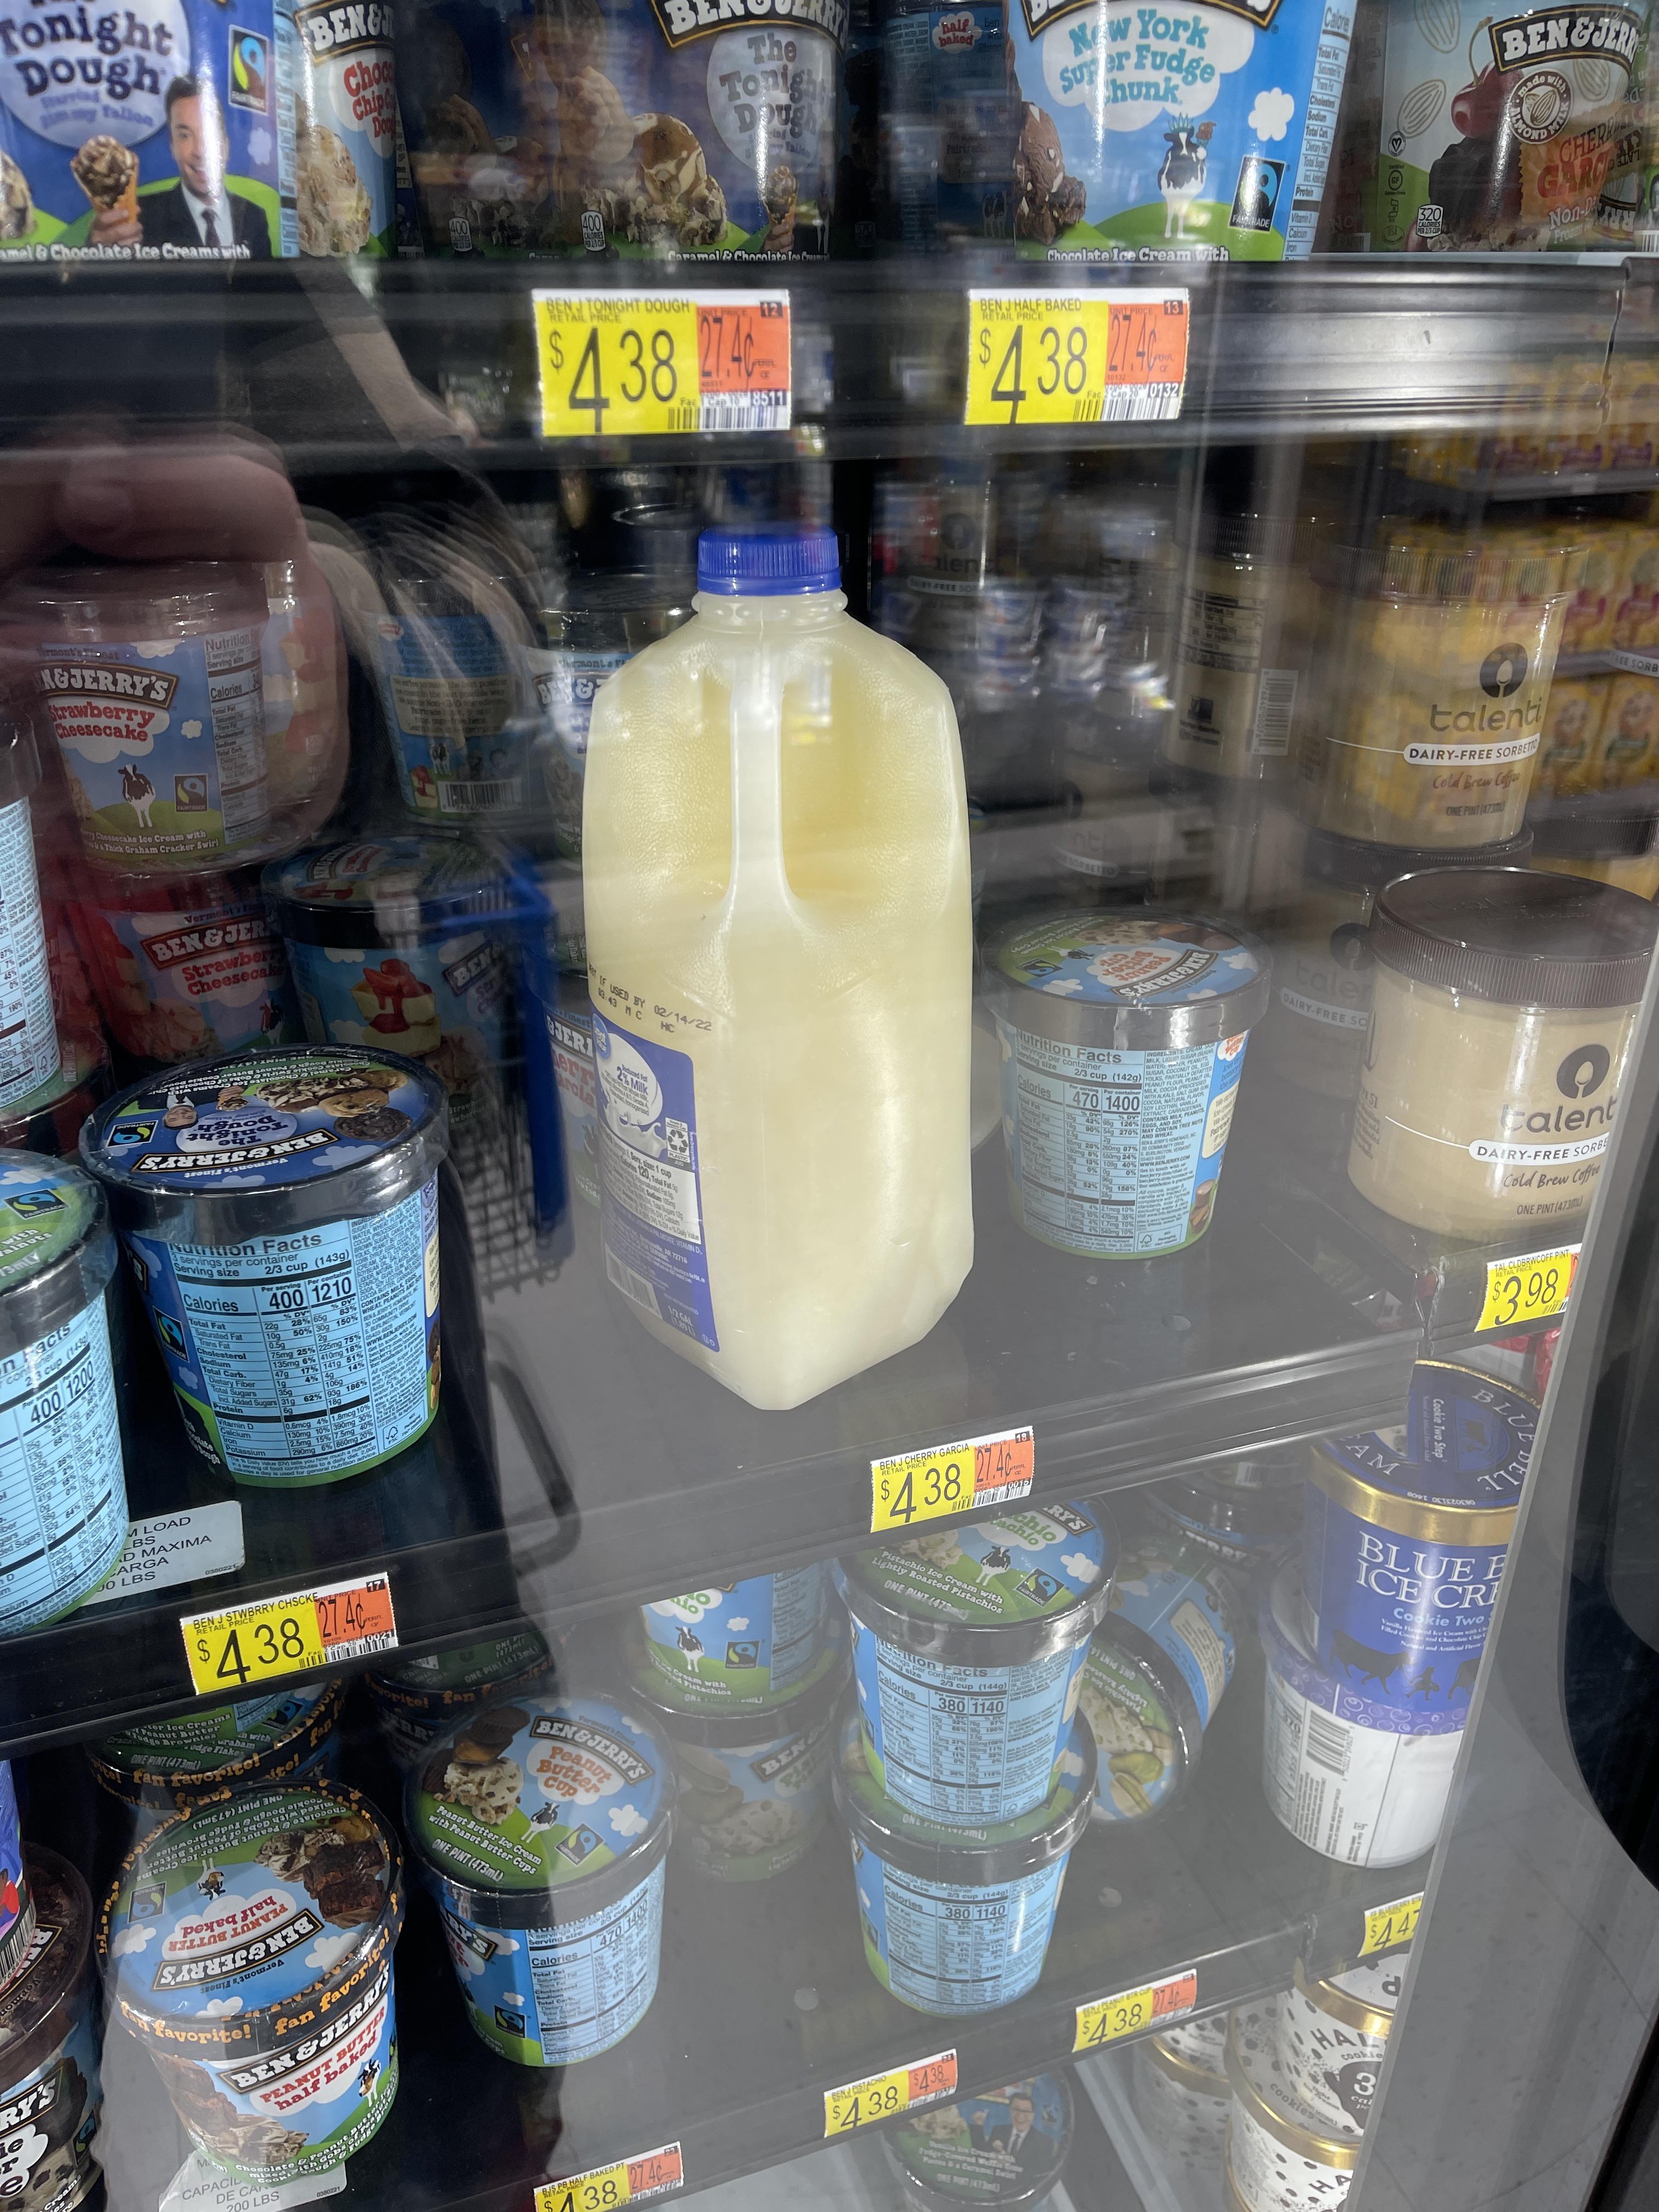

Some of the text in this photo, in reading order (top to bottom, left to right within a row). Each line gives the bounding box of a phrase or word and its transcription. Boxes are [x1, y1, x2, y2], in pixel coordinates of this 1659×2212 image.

[0, 6, 173, 55] Tonight
[941, 19, 970, 36] half
[1137, 9, 1209, 49] York
[747, 32, 797, 64] The
[939, 33, 973, 48] baked
[1134, 44, 1216, 86] Fudge
[15, 55, 160, 100] Dough
[719, 64, 827, 104] Tonight
[733, 104, 817, 138] Dough
[583, 216, 600, 231] 400
[1418, 208, 1441, 222] 320
[50, 242, 250, 260] Chocolate Ice Creams with
[1047, 246, 1228, 261] Chocolate Ice Cream with
[546, 298, 573, 313] BEN
[586, 298, 641, 313] TONIGHT
[645, 298, 690, 313] DOUGH
[980, 299, 1002, 311] BEN
[1014, 299, 1041, 311] HALF
[1046, 299, 1081, 311] BAKED
[1166, 302, 1180, 314] 13
[550, 314, 622, 323] RETAIL PRICE
[983, 312, 1043, 321] RETAIL PRICE
[753, 391, 785, 405] 8511
[1152, 384, 1178, 397] 0132
[1430, 698, 1542, 733] talenti
[57, 723, 148, 742] Cheesecake
[1409, 747, 1493, 760] DAIRY-FREE
[1432, 770, 1493, 789] Cold Brew
[155, 831, 206, 842] Cream with
[160, 843, 194, 853] Cracker
[197, 839, 219, 849] Swirl
[610, 983, 628, 1001] USED
[634, 996, 645, 1007] BY
[654, 1005, 712, 1031] 02/14/22
[1283, 994, 1346, 1023] DAIRY-FREE
[1063, 1059, 1102, 1070] container
[1077, 1047, 1121, 1063] Facts
[617, 1066, 648, 1096] 2% Milk
[1090, 1071, 1142, 1082] cup (142g)
[1073, 1091, 1140, 1111] 470 1400
[198, 1115, 273, 1131] Dough
[185, 1124, 289, 1142] Tonight
[218, 1135, 261, 1146] The
[1477, 1146, 1568, 1160] DAIRY-FREE
[661, 1170, 672, 1179] cup
[1503, 1163, 1601, 1188] Cold Brew Coffee
[1517, 1204, 1534, 1215] ONE
[1536, 1203, 1554, 1214] PINT
[263, 1234, 322, 1254] Facts
[174, 1249, 349, 1277] Serving size 2/3 cup (143g)
[246, 1253, 298, 1266] container
[1494, 1250, 1569, 1272] TAL CLDBRWCOFF PINT
[1496, 1268, 1515, 1278] RETAIL
[183, 1277, 352, 1312] Calories 400 1210
[31, 1360, 95, 1424] 400 1200
[1017, 1433, 1027, 1442] 18
[880, 1460, 897, 1470] BEN
[905, 1449, 936, 1464] CHERRY
[939, 1443, 969, 1457] GARCIA
[1008, 1479, 1029, 1488] 0015
[143, 1517, 191, 1535] LOAD
[142, 1536, 211, 1559] MAXIMA
[1358, 1531, 1475, 1582] BLUE
[121, 1572, 156, 1587] LBS
[205, 1565, 236, 1575] 0380221
[881, 1551, 1003, 1604] Pistachio Ice Cream with
[872, 1558, 1003, 1615] Lightly Roasted Pistachios
[1357, 1558, 1422, 1603] ICE
[194, 1618, 215, 1629] BEN
[226, 1602, 274, 1622] STWBRRY
[278, 1593, 318, 1610] CHSCKE
[1393, 1608, 1484, 1626] Cookie Two
[196, 1618, 254, 1635] RETAIL PRICE
[367, 1630, 392, 1642] 0021
[938, 1697, 1003, 1714] 380 1140
[133, 1753, 261, 1787] fan favorite!
[549, 1745, 613, 1785] Peanut
[537, 1758, 601, 1795] Butter
[544, 1776, 577, 1797] Cup
[437, 1805, 542, 1866] Peanut Butter Ice Cream
[428, 1815, 537, 1876] with Peanut Butter Cups
[432, 1838, 453, 1854] ONE
[449, 1848, 471, 1867] PINT
[182, 1895, 276, 1938] half baked
[168, 1903, 288, 1951] PEANUT BUTTER
[600, 1927, 622, 1946] 470
[532, 1952, 578, 1967] Calories
[153, 2011, 315, 2044] favorite! fan
[259, 2006, 385, 2103] PEANUT BUTTER
[274, 2031, 378, 2111] half baked
[569, 2174, 587, 2187] HALF
[590, 2166, 614, 2179] BAKED
[253, 2191, 279, 2207] LBS
